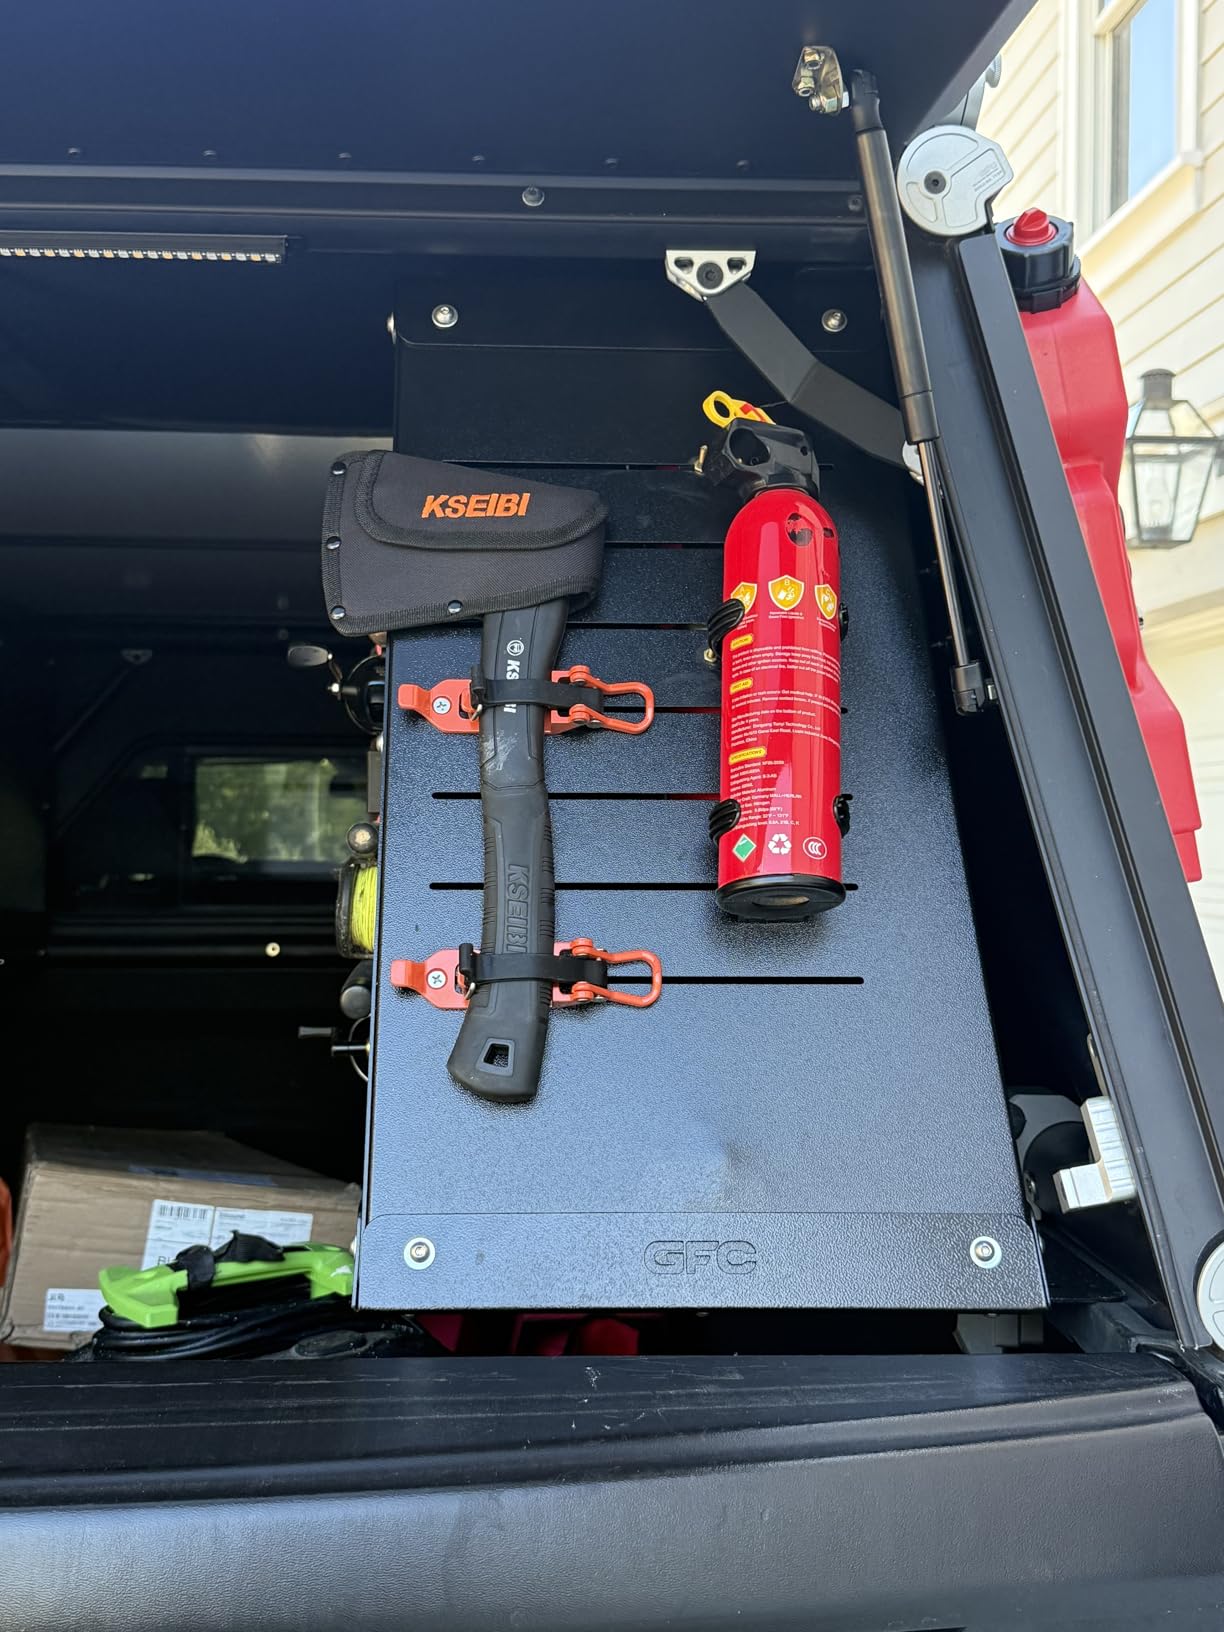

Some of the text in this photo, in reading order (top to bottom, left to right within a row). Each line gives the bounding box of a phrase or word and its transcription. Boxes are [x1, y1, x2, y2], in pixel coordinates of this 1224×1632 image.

[421, 493, 531, 518] KSEIBI
[504, 659, 520, 713] KSI
[506, 864, 530, 953] KSEIBI
[643, 1240, 757, 1275] GFC
